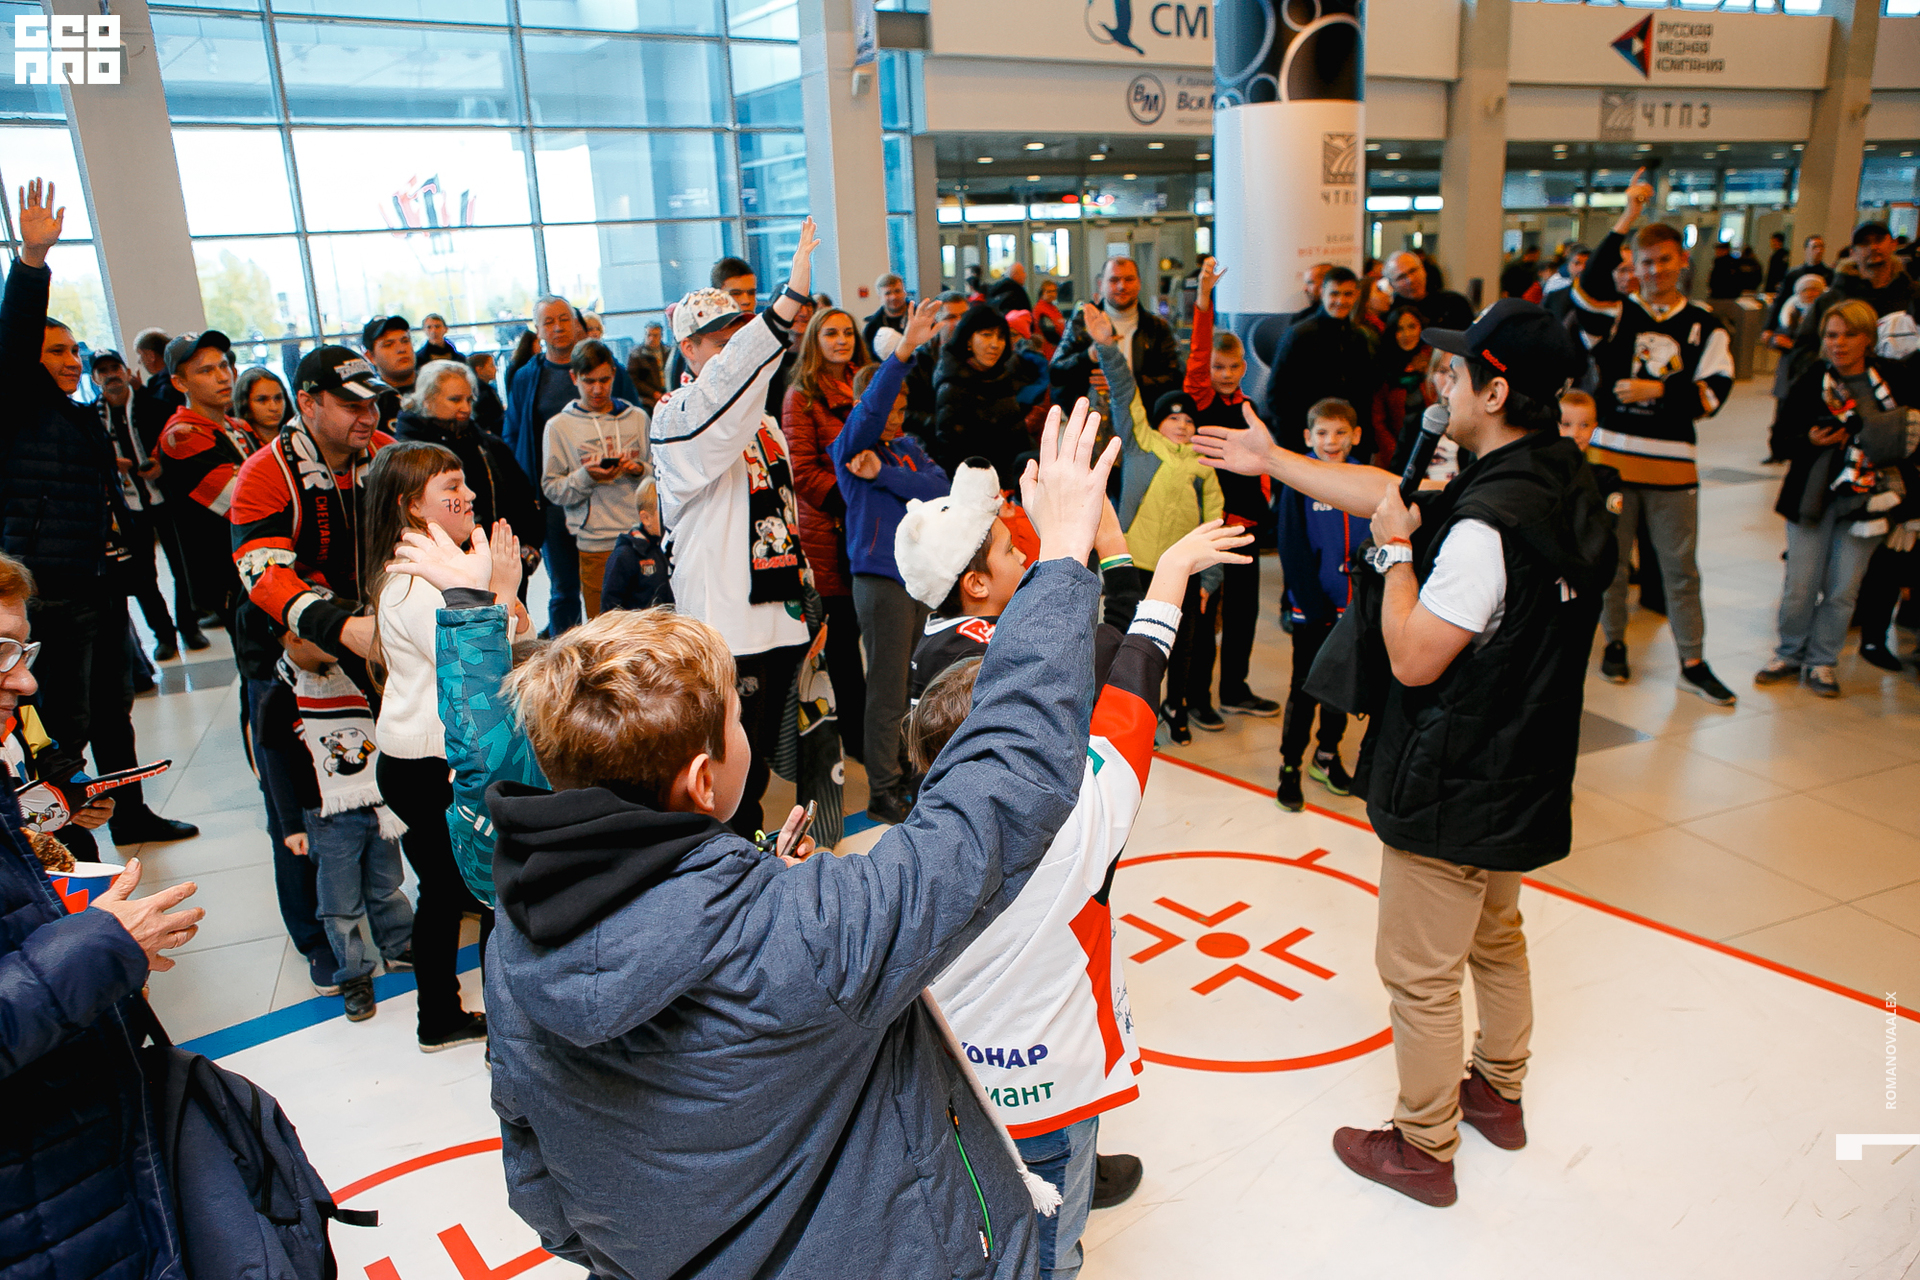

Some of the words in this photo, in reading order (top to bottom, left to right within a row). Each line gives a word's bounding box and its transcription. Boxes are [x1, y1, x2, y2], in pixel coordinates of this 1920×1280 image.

[1658, 22, 1713, 37] РУССКАЯ
[1641, 102, 1711, 128] ЧТПЗ
[1481, 349, 1508, 373] Reebok
[441, 498, 462, 514] 78
[315, 496, 331, 565] CHELYABINS
[961, 1042, 1049, 1070] ОНАР
